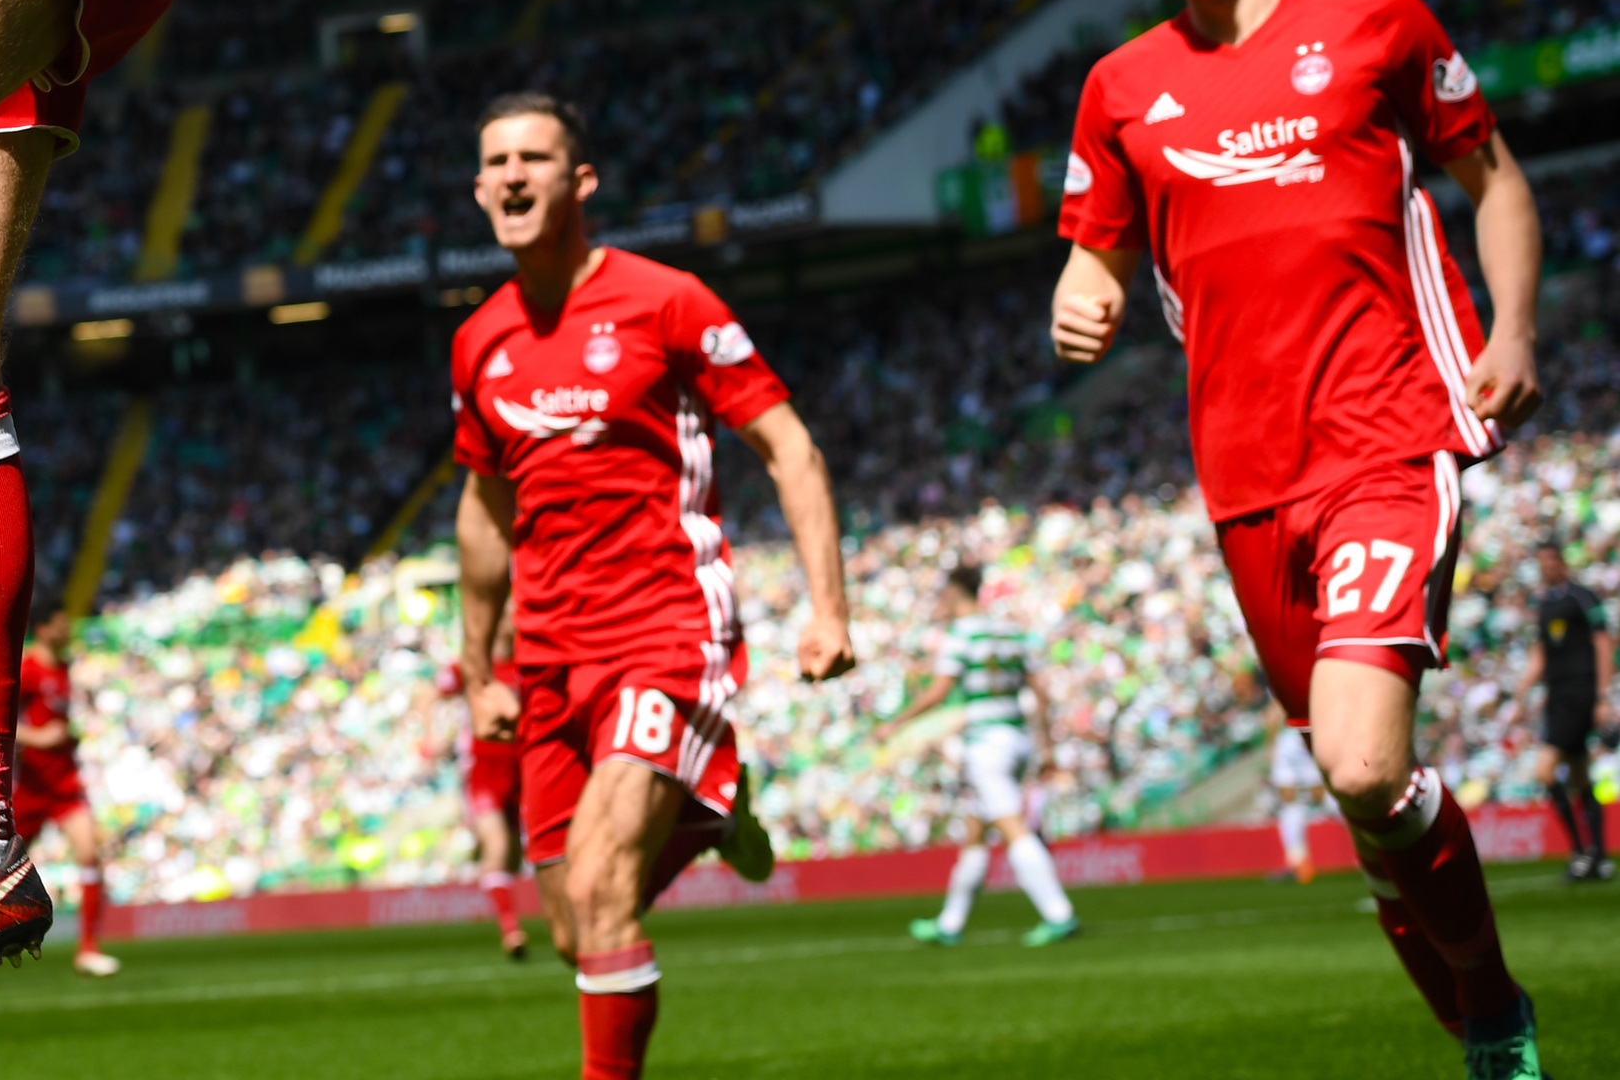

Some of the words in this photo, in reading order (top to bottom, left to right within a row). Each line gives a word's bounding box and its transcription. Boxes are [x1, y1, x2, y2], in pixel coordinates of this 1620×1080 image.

[1217, 116, 1320, 159] Saltire
[1326, 539, 1414, 618] 27
[612, 687, 677, 754] 18
